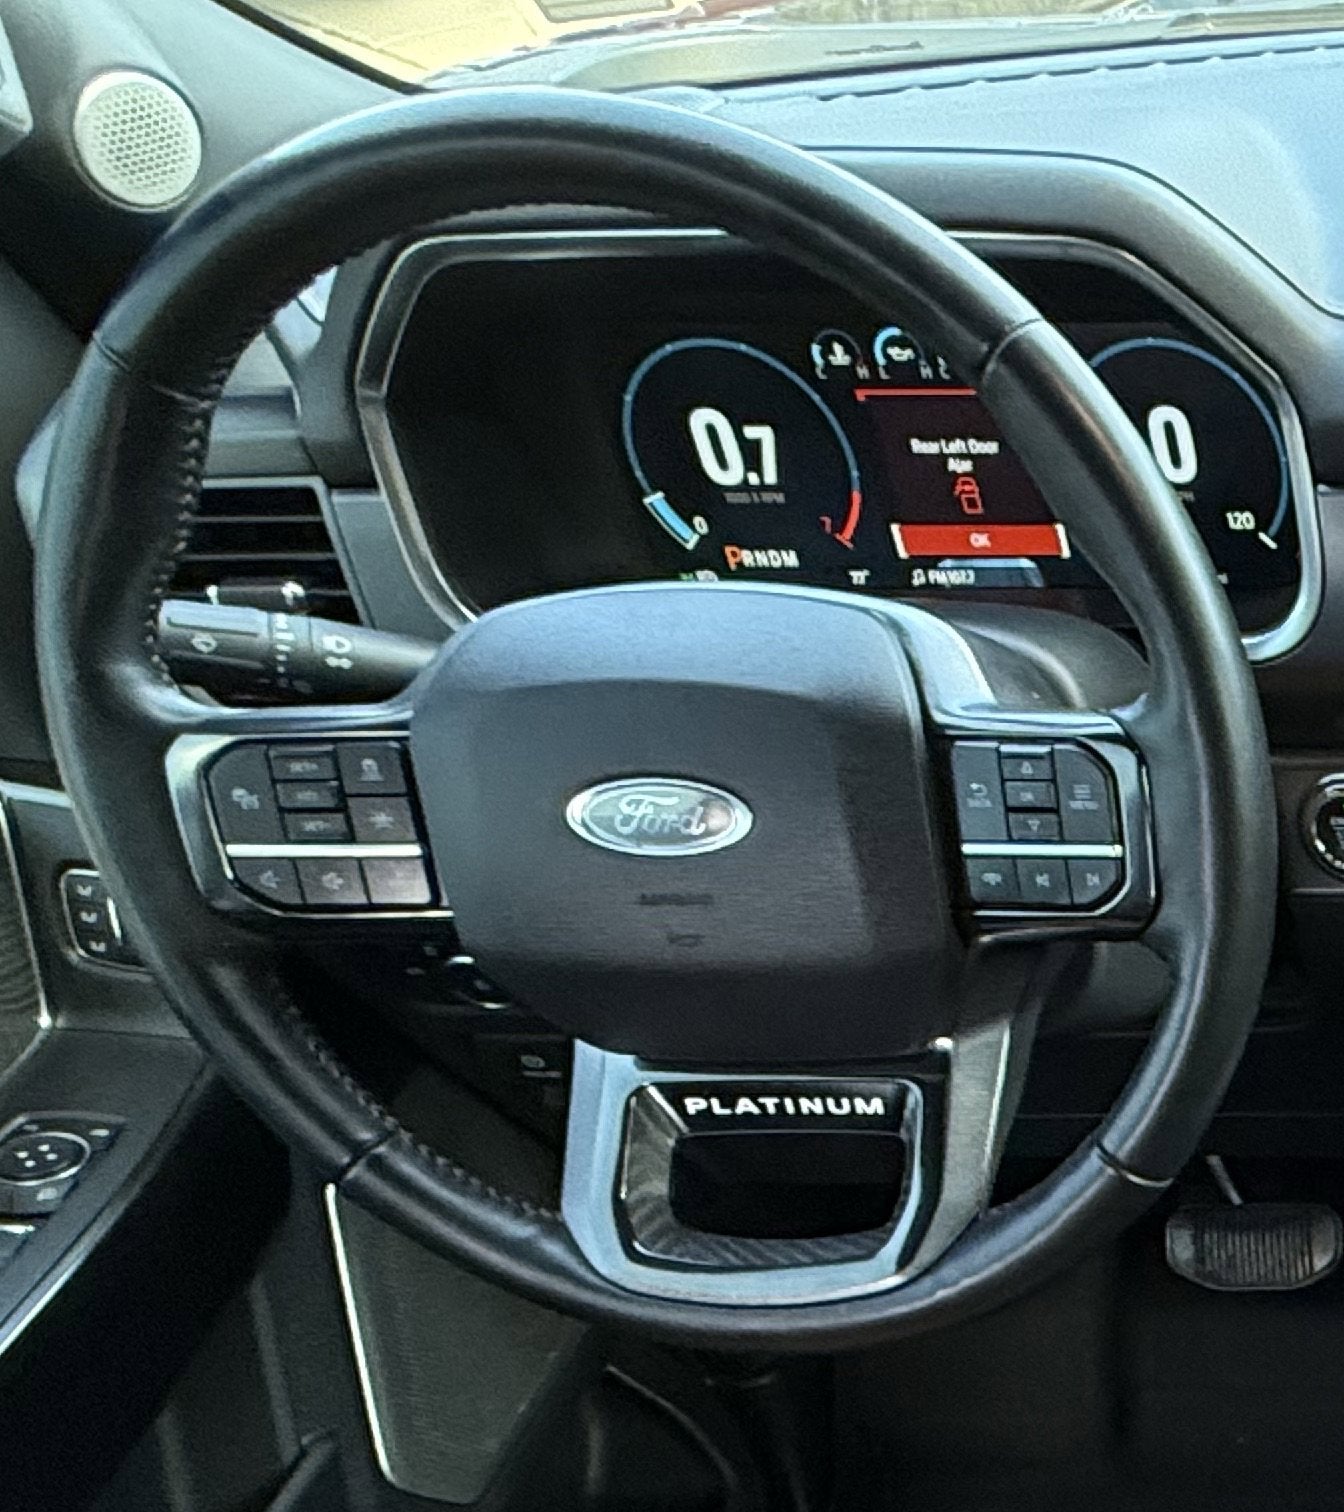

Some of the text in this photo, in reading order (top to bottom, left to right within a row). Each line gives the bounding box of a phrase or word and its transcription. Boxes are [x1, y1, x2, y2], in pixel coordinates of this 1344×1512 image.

[688, 406, 778, 487] 0.7
[910, 438, 1000, 455] Rear Left Door
[1147, 403, 1198, 484] 0
[692, 515, 710, 536] 0
[1225, 510, 1256, 530] 120
[614, 793, 706, 837] Ford
[683, 1095, 886, 1117] PLATINUM
